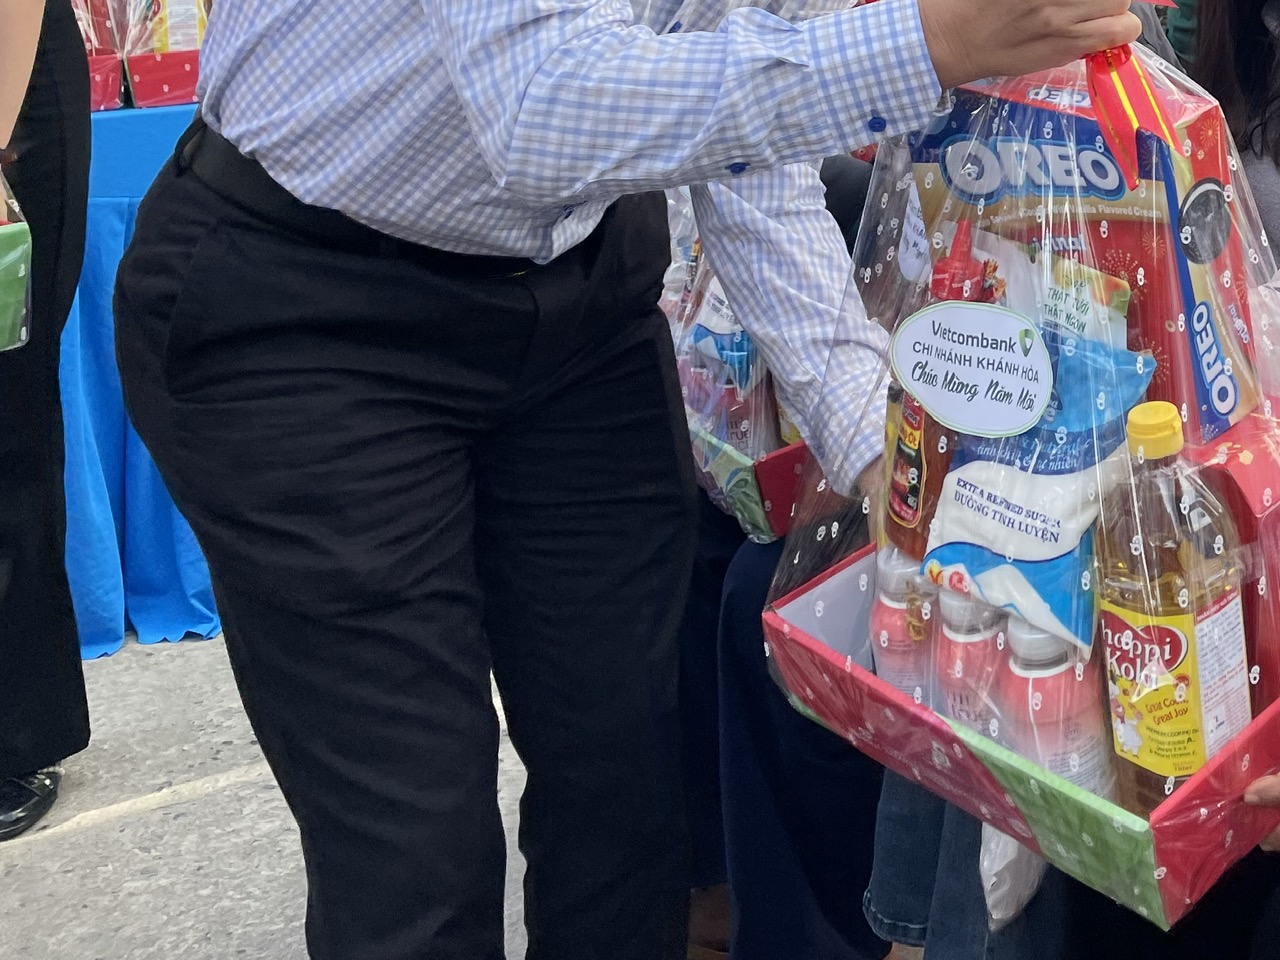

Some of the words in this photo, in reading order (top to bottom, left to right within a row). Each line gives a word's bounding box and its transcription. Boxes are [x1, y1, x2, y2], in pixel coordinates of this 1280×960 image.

[943, 138, 1121, 195] OREO
[932, 320, 1017, 353] Vietcombank
[1193, 304, 1236, 414] OREO
[911, 360, 938, 388] Chúc
[984, 378, 1013, 406] Năm
[913, 341, 933, 357] CHI
[934, 345, 972, 368] NHÁNH
[976, 354, 1020, 377] KHÁNH
[1020, 363, 1039, 384] HÒA
[954, 490, 989, 517] ĐƯỜNG
[1018, 520, 1060, 544] LUYỆN
[1153, 711, 1173, 725] Great
[1174, 707, 1189, 718] Joy
